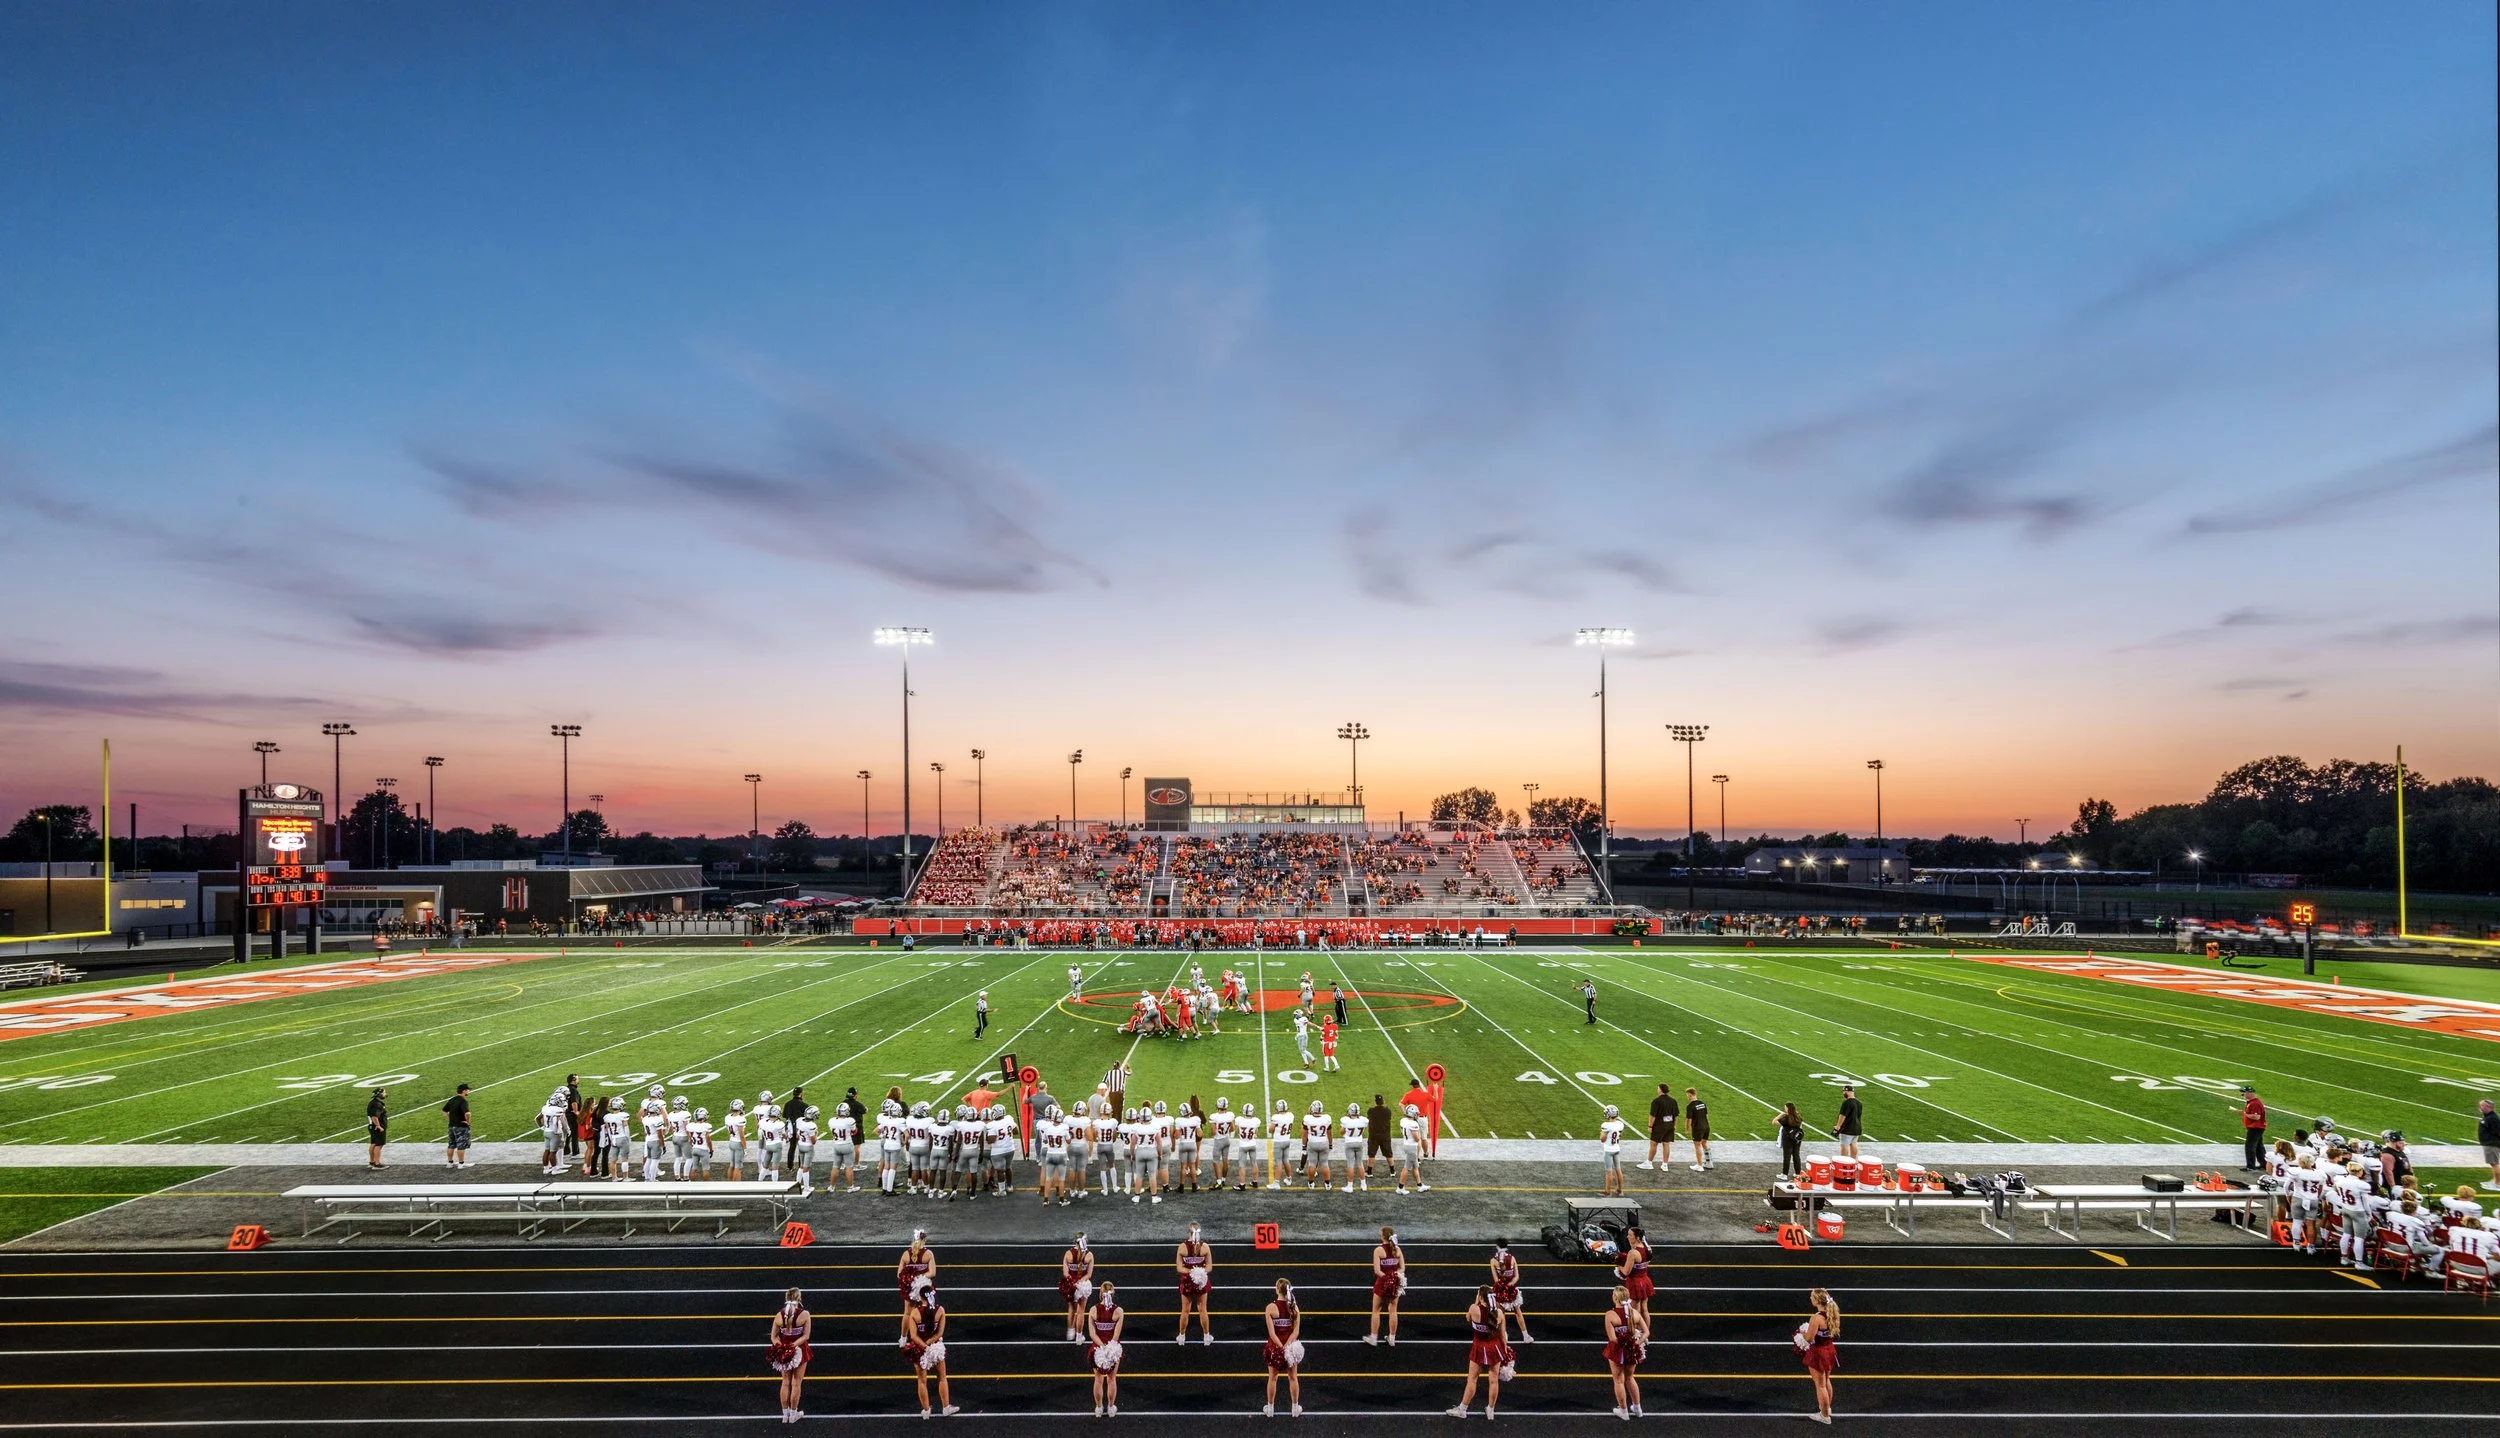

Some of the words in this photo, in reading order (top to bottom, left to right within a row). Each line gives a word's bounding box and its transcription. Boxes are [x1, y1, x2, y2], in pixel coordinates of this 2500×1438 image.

[262, 819, 292, 827] Upcoming
[281, 866, 301, 878] 3:39
[291, 890, 303, 902] 40
[311, 890, 318, 901] 3
[503, 877, 529, 912] H
[2293, 905, 2312, 922] 25
[1005, 1056, 1014, 1073] 1
[1213, 1069, 1319, 1084] 50
[1515, 1070, 1623, 1086] 40
[1217, 1122, 1232, 1135] 57
[1240, 1127, 1255, 1140] 36
[1310, 1125, 1327, 1137] 52
[1347, 1128, 1364, 1138] 77
[933, 1134, 948, 1147] 32
[964, 1131, 980, 1145] 85
[1139, 1134, 1155, 1145] 73
[2276, 1164, 2285, 1178] 6
[2302, 1180, 2320, 1194] 13
[232, 1228, 256, 1247] 30
[785, 1227, 804, 1245] 40
[1257, 1226, 1277, 1244] 50
[1785, 1228, 1806, 1247] 40
[2462, 1237, 2479, 1256] 11
